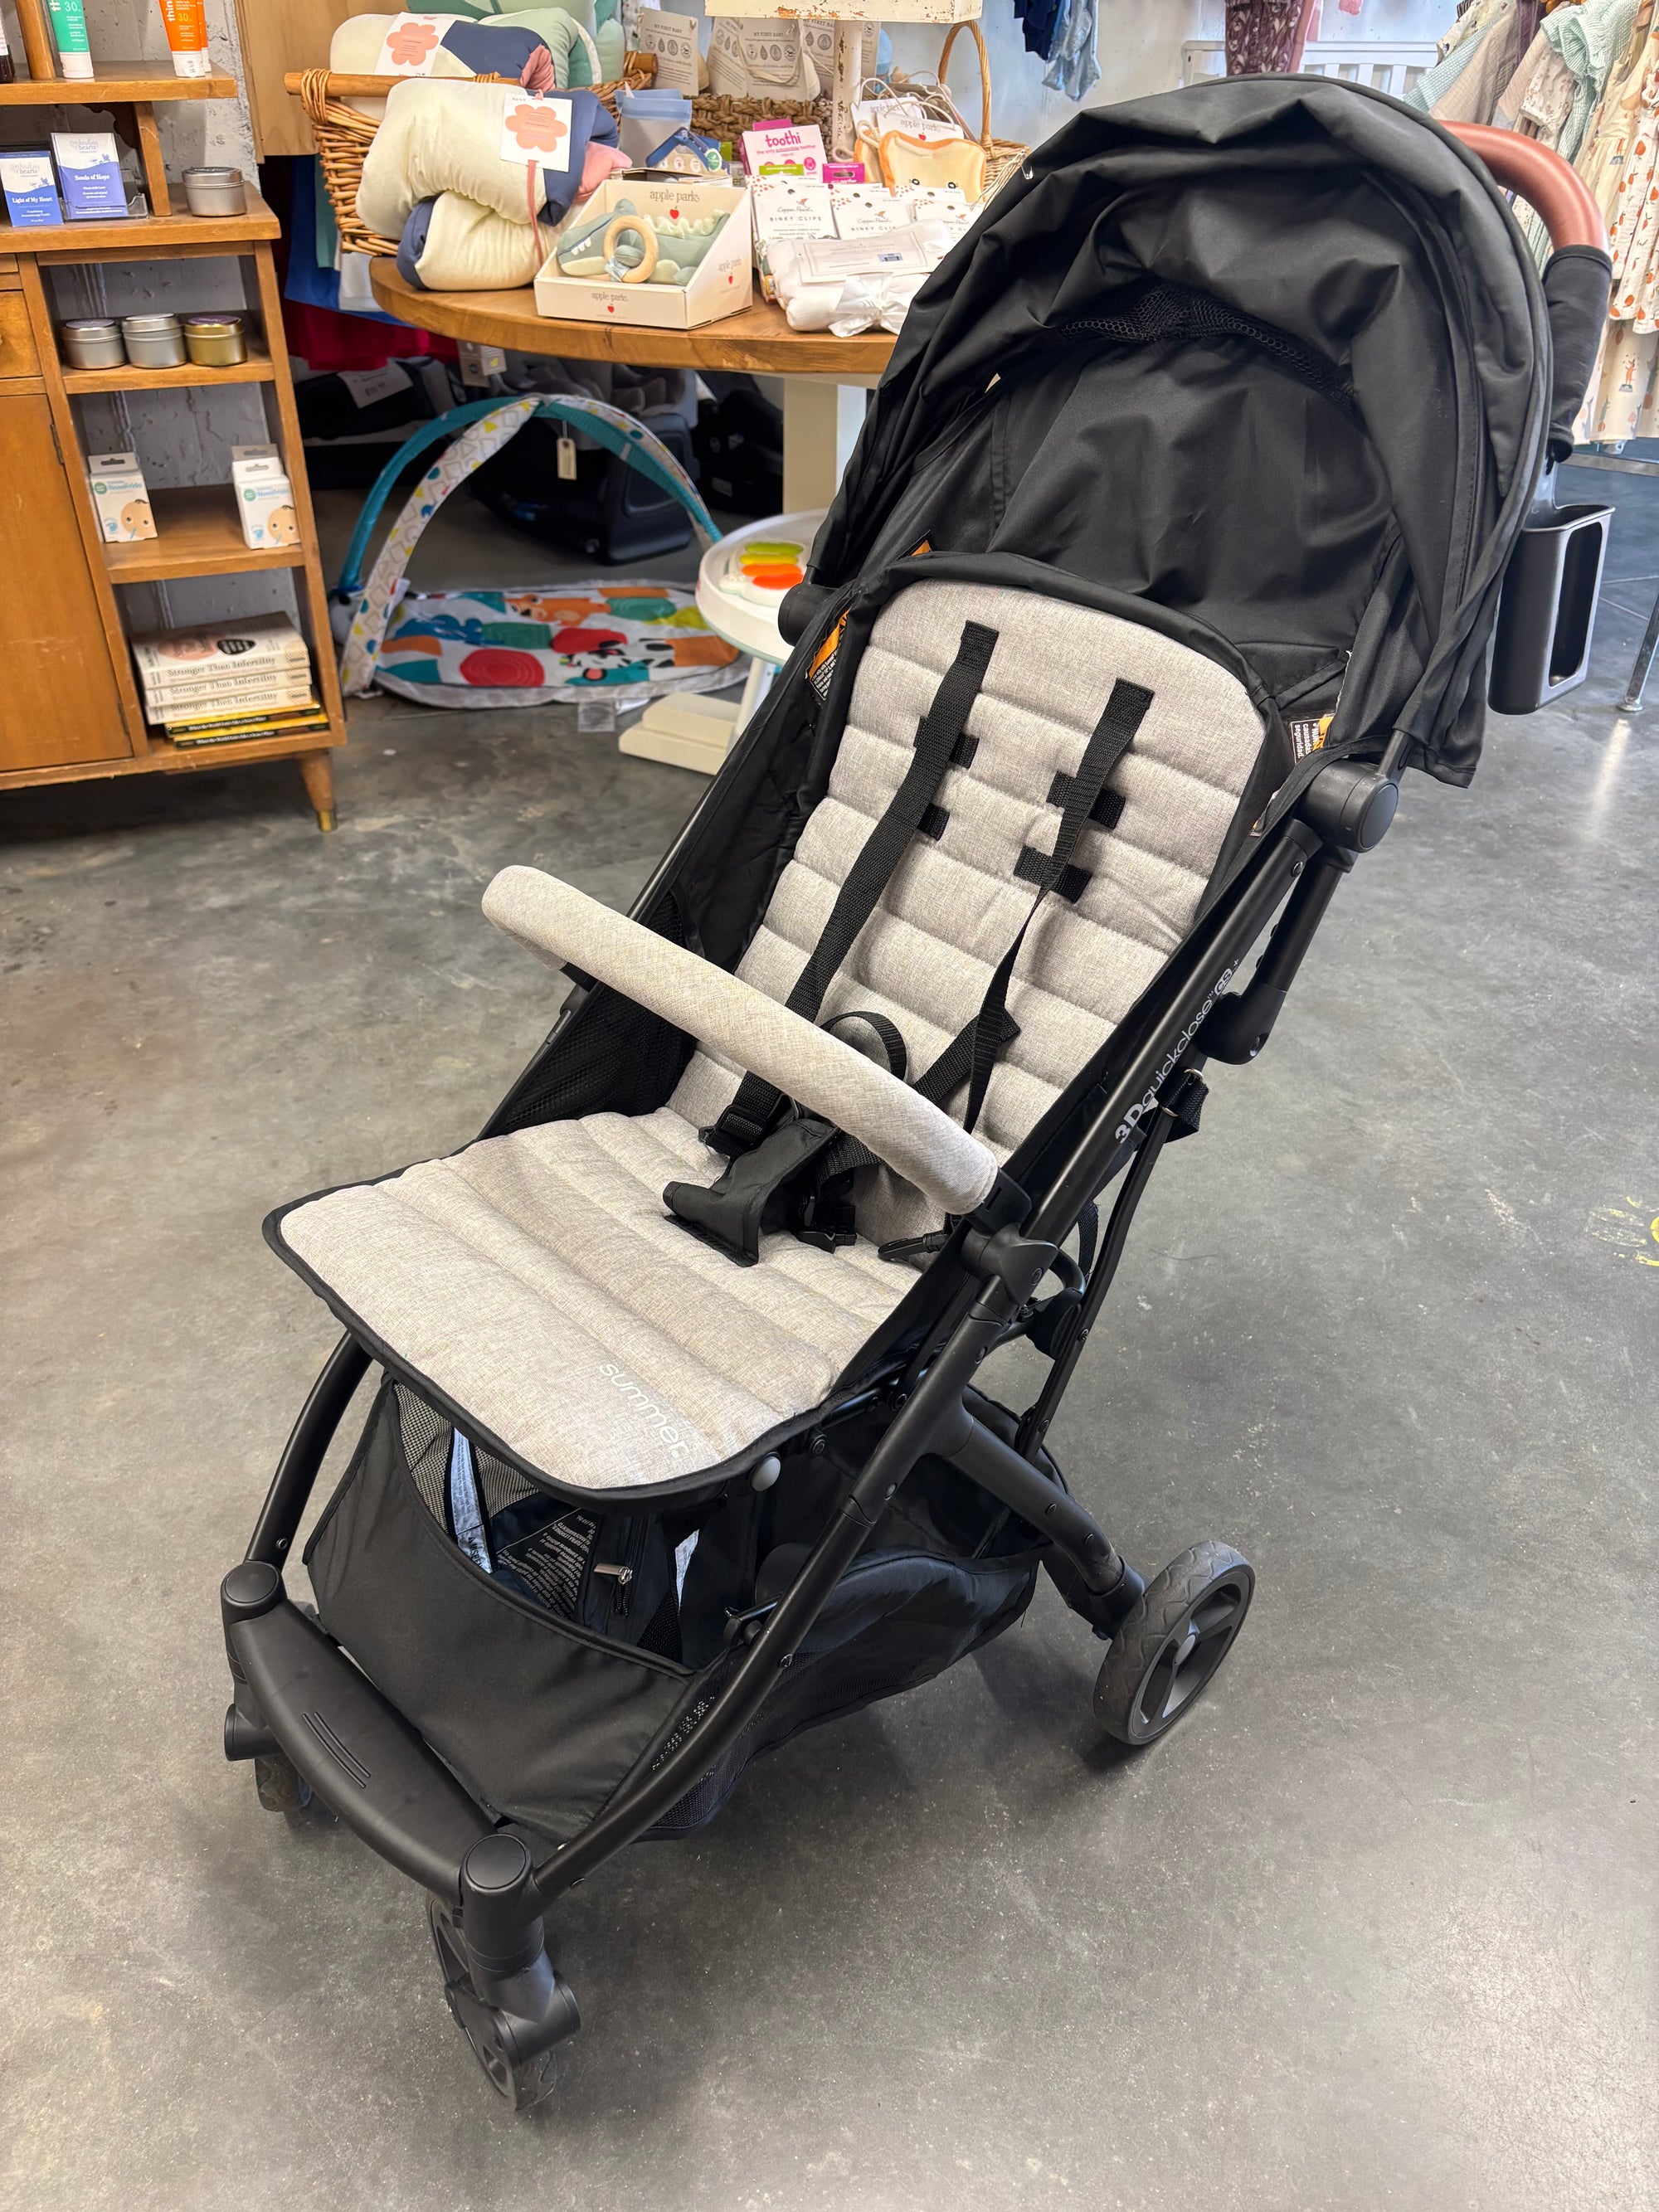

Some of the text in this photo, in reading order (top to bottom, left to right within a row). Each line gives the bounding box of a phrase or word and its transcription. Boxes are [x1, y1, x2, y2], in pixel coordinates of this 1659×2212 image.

[65, 2, 77, 12] 30
[900, 119, 921, 129] apple
[765, 130, 801, 147] toothi
[650, 190, 674, 203] apple
[591, 292, 609, 303] apple
[168, 656, 275, 678] Stronger Than Infertility
[170, 673, 277, 695] Stronger Than Infertility
[172, 692, 277, 712] Stronger Than Infertility
[1294, 724, 1304, 758] seguridad.
[1303, 724, 1311, 754] causadas
